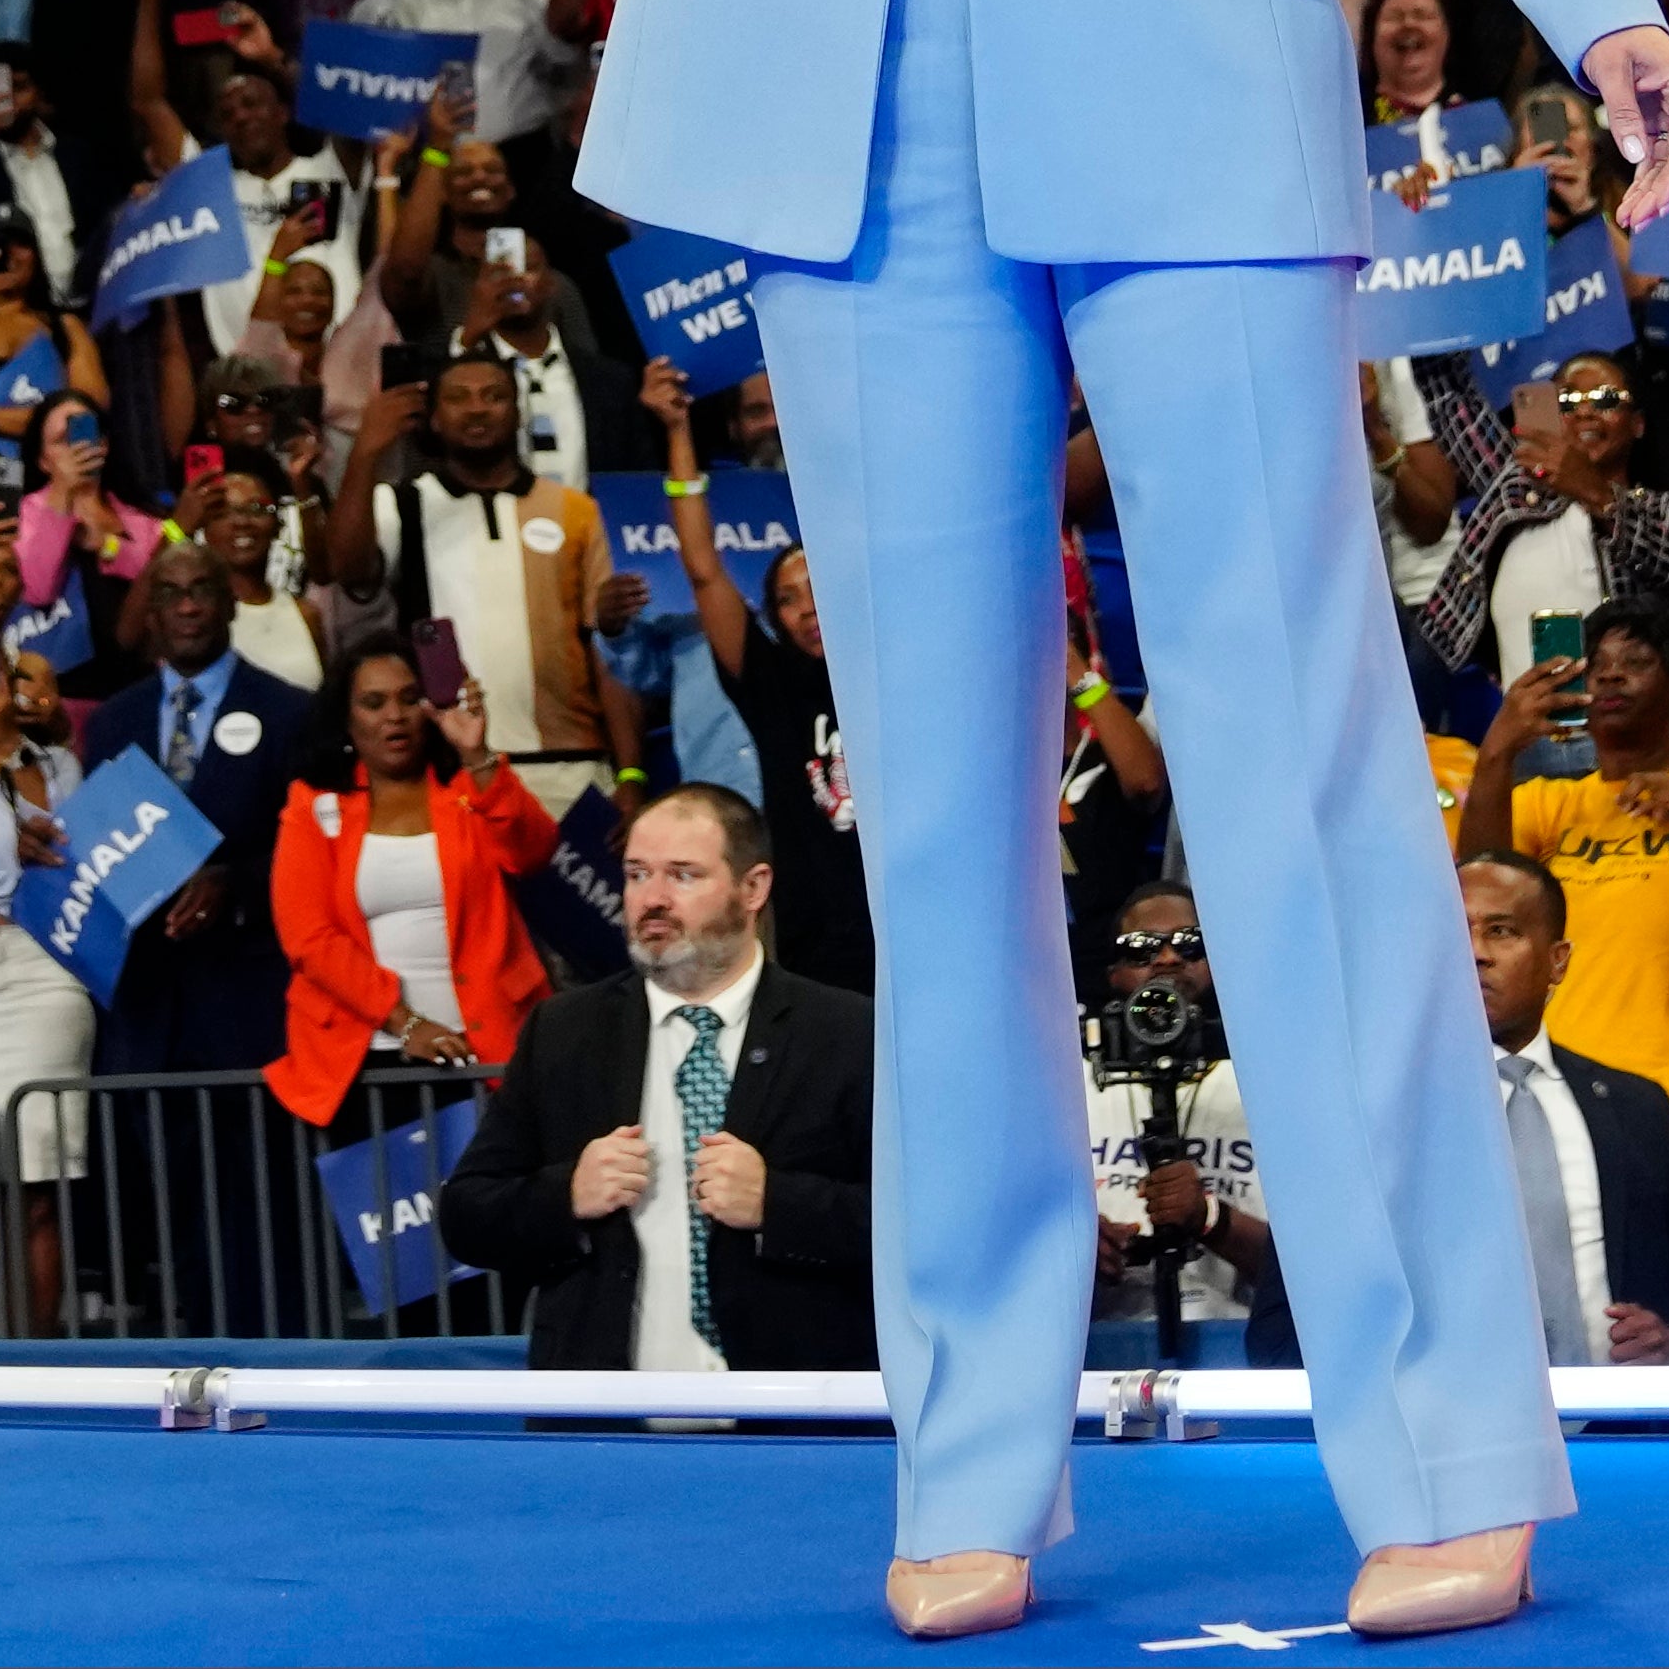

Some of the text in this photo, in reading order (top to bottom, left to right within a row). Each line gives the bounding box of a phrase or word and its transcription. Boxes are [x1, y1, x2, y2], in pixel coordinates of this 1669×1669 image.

[316, 64, 438, 104] AMALA
[644, 258, 748, 320] When w
[681, 299, 746, 343] WE
[622, 521, 793, 553] KAALA
[50, 801, 168, 954] KAMALA
[551, 842, 626, 928] KAMA
[1092, 1137, 1254, 1173] HARIS
[1107, 1173, 1253, 1198] PRENT
[358, 1191, 434, 1244] KAM
